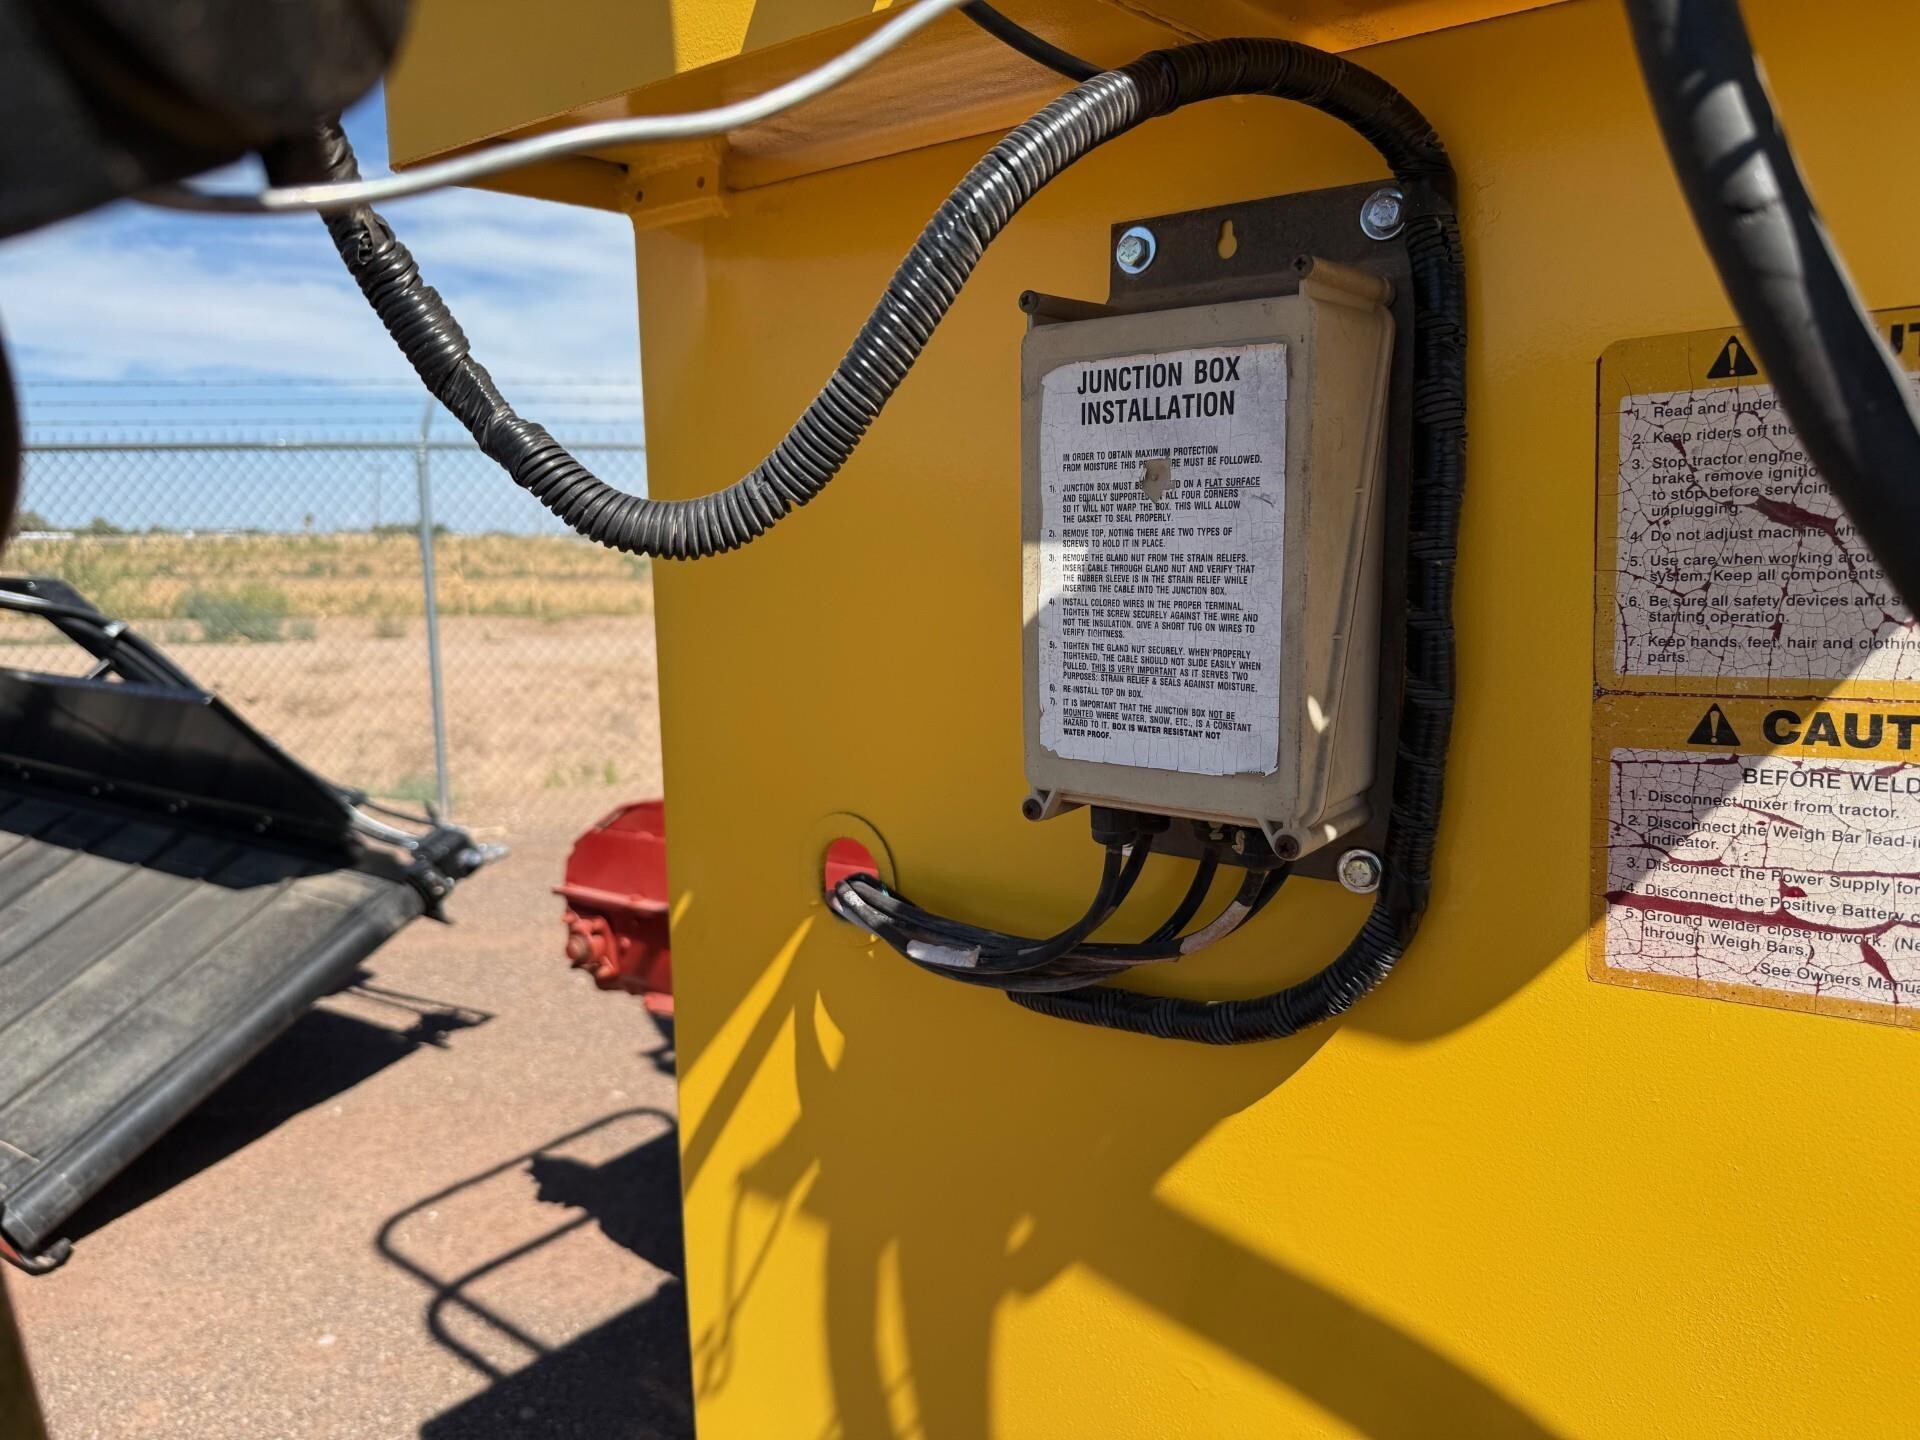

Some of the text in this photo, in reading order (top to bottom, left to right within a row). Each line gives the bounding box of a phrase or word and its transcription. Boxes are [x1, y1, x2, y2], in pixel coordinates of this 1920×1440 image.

[1077, 356, 1240, 394] JUNCTION BOX
[1081, 391, 1234, 425] INSTALLATION
[1654, 406, 1692, 418] Read
[1698, 402, 1726, 415] and
[1632, 434, 1644, 444] 2.
[1654, 432, 1691, 444] Keep
[1697, 426, 1741, 440] riders
[1747, 425, 1768, 438] off
[1073, 452, 1094, 461] ORDER
[1108, 450, 1132, 459] OBTAIN
[1135, 448, 1170, 458] MAXIMUM
[1174, 446, 1218, 456] PROTECTION
[1184, 457, 1203, 466] MUST
[1220, 455, 1262, 465] FOLLOWED.
[1063, 463, 1080, 472] FROM
[1084, 462, 1117, 471] MOISTURE
[1632, 460, 1644, 469] 3.
[1652, 456, 1687, 469] Stop
[1693, 455, 1743, 466] tractor
[1705, 470, 1763, 481] remove
[1652, 490, 1665, 500] to
[1671, 489, 1704, 501] stop
[1710, 487, 1759, 497] before
[1175, 502, 1191, 510] THIS
[1194, 501, 1211, 510] WILL
[1215, 501, 1240, 509] ALLOW
[1652, 504, 1742, 517] unplugging.
[1136, 513, 1173, 522] PROPERLY.
[1651, 531, 1671, 541] Do
[1676, 530, 1700, 540] not
[1706, 528, 1752, 541] adjust
[1758, 527, 1826, 538] machine
[1630, 552, 1832, 566] 5. Use care when working
[1650, 568, 1884, 584] system. Keep all components
[1629, 595, 1885, 608] 6. Be sure all safety devices and
[1649, 612, 1789, 624] starting operation.
[1628, 637, 1640, 646] 7.
[1648, 636, 1685, 646] Keep
[1691, 637, 1741, 648] hands,
[1788, 637, 1817, 648] hair
[1823, 638, 1852, 648] and
[1648, 653, 1688, 664] parts.
[1063, 685, 1099, 694] RE-INSTALL
[1129, 689, 1143, 698] BOX.
[1063, 719, 1088, 727] HAZARD
[1138, 725, 1160, 733] WATER
[1206, 731, 1220, 739] NOT
[1087, 730, 1111, 739] PROOF.
[1744, 768, 1840, 789] BEFORE
[1630, 790, 1899, 818] 1. Disconnect mixer from tractor.
[1628, 815, 1640, 826] 2.
[1648, 816, 1736, 834] Disconnect
[1742, 824, 1766, 836] the
[1774, 826, 1824, 842] Weigh
[1832, 830, 1860, 843] Bar
[1648, 835, 1718, 850] indicator.
[1627, 858, 1639, 868] 3.
[1646, 859, 1734, 877] Disconnect
[1741, 868, 1765, 879] the
[1772, 871, 1823, 885] Power
[1830, 876, 1890, 895] Supply
[1626, 883, 1904, 921] 4. Disconnect the Positive Battery
[1626, 908, 1886, 947] 5. Ground welder close to work.
[1646, 926, 1704, 945] through
[1711, 934, 1759, 951] Weigh
[1761, 963, 1790, 977] See
[1798, 967, 1860, 986] Owners
